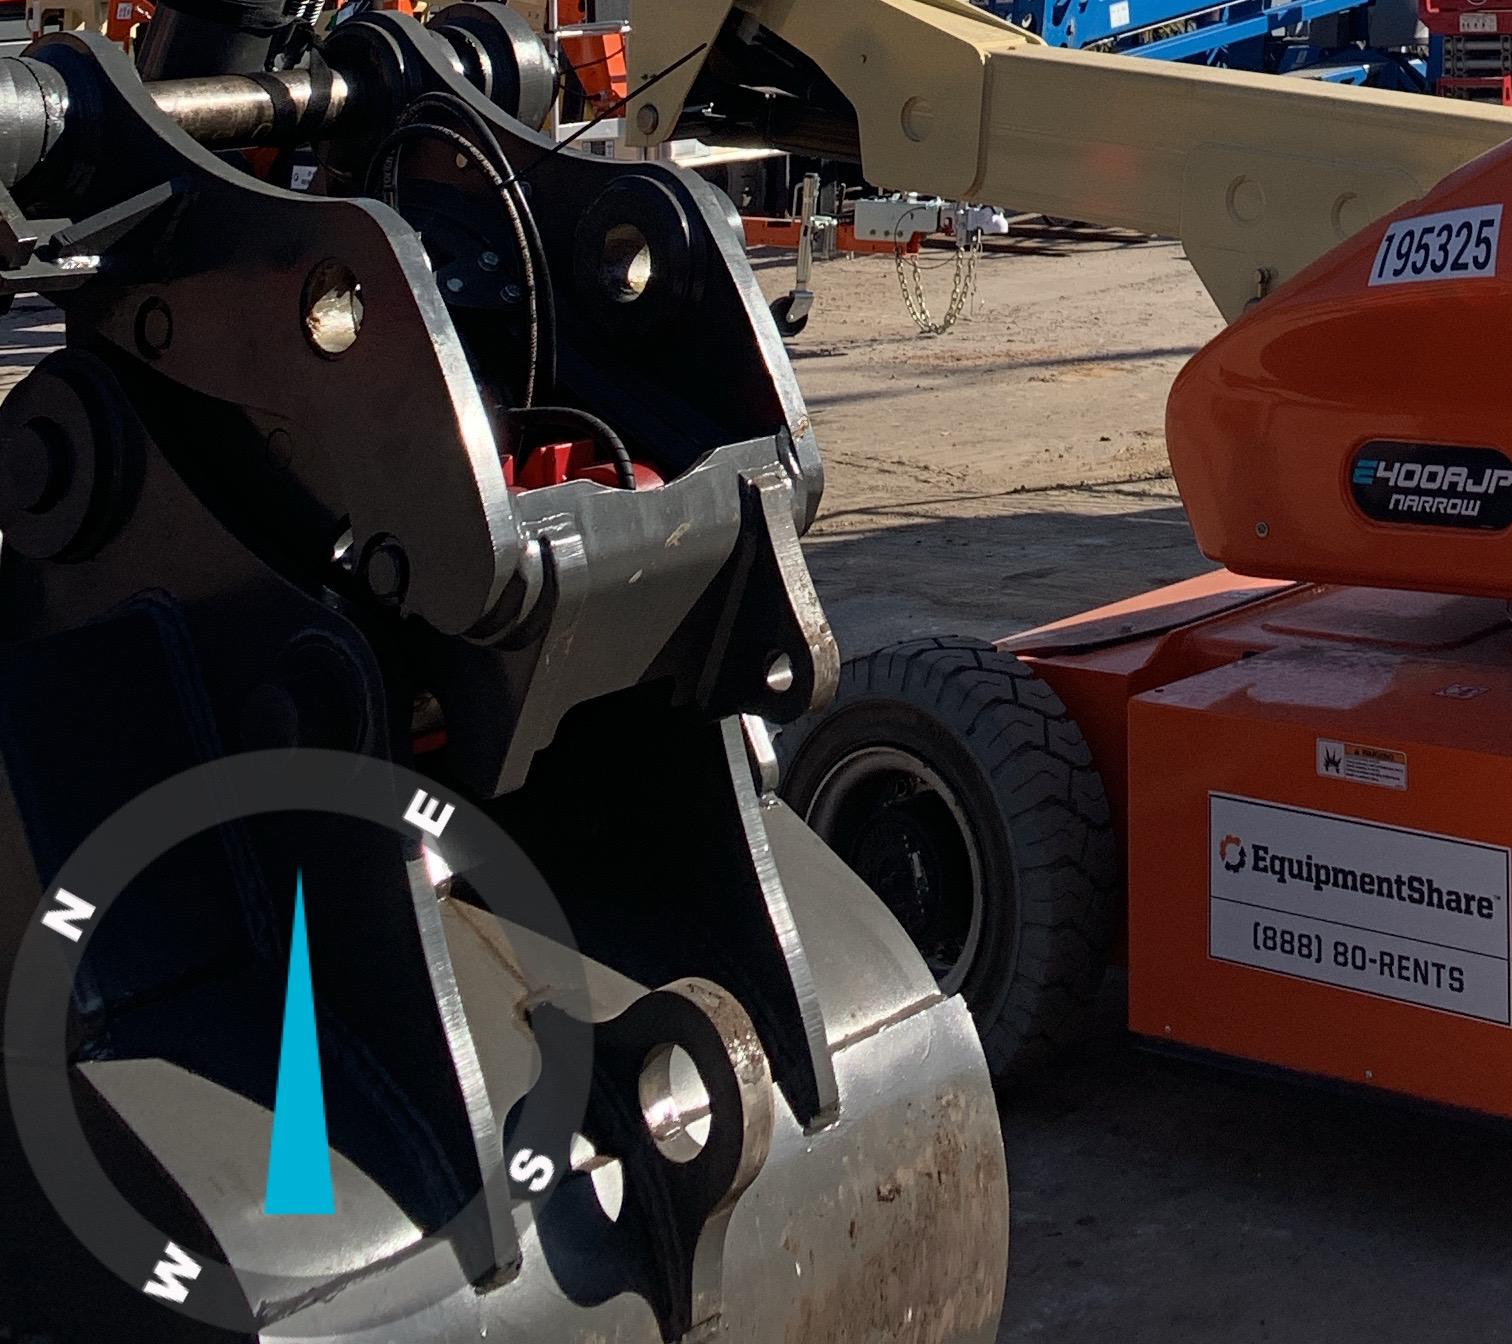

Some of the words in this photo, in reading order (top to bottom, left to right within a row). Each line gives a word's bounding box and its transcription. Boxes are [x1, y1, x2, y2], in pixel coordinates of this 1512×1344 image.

[1377, 218, 1496, 279] 195325
[1388, 492, 1482, 517] NARROW
[1251, 843, 1496, 920] EquipmentShare
[1252, 921, 1323, 964] (888)
[1332, 941, 1466, 994] 80-RENTS
